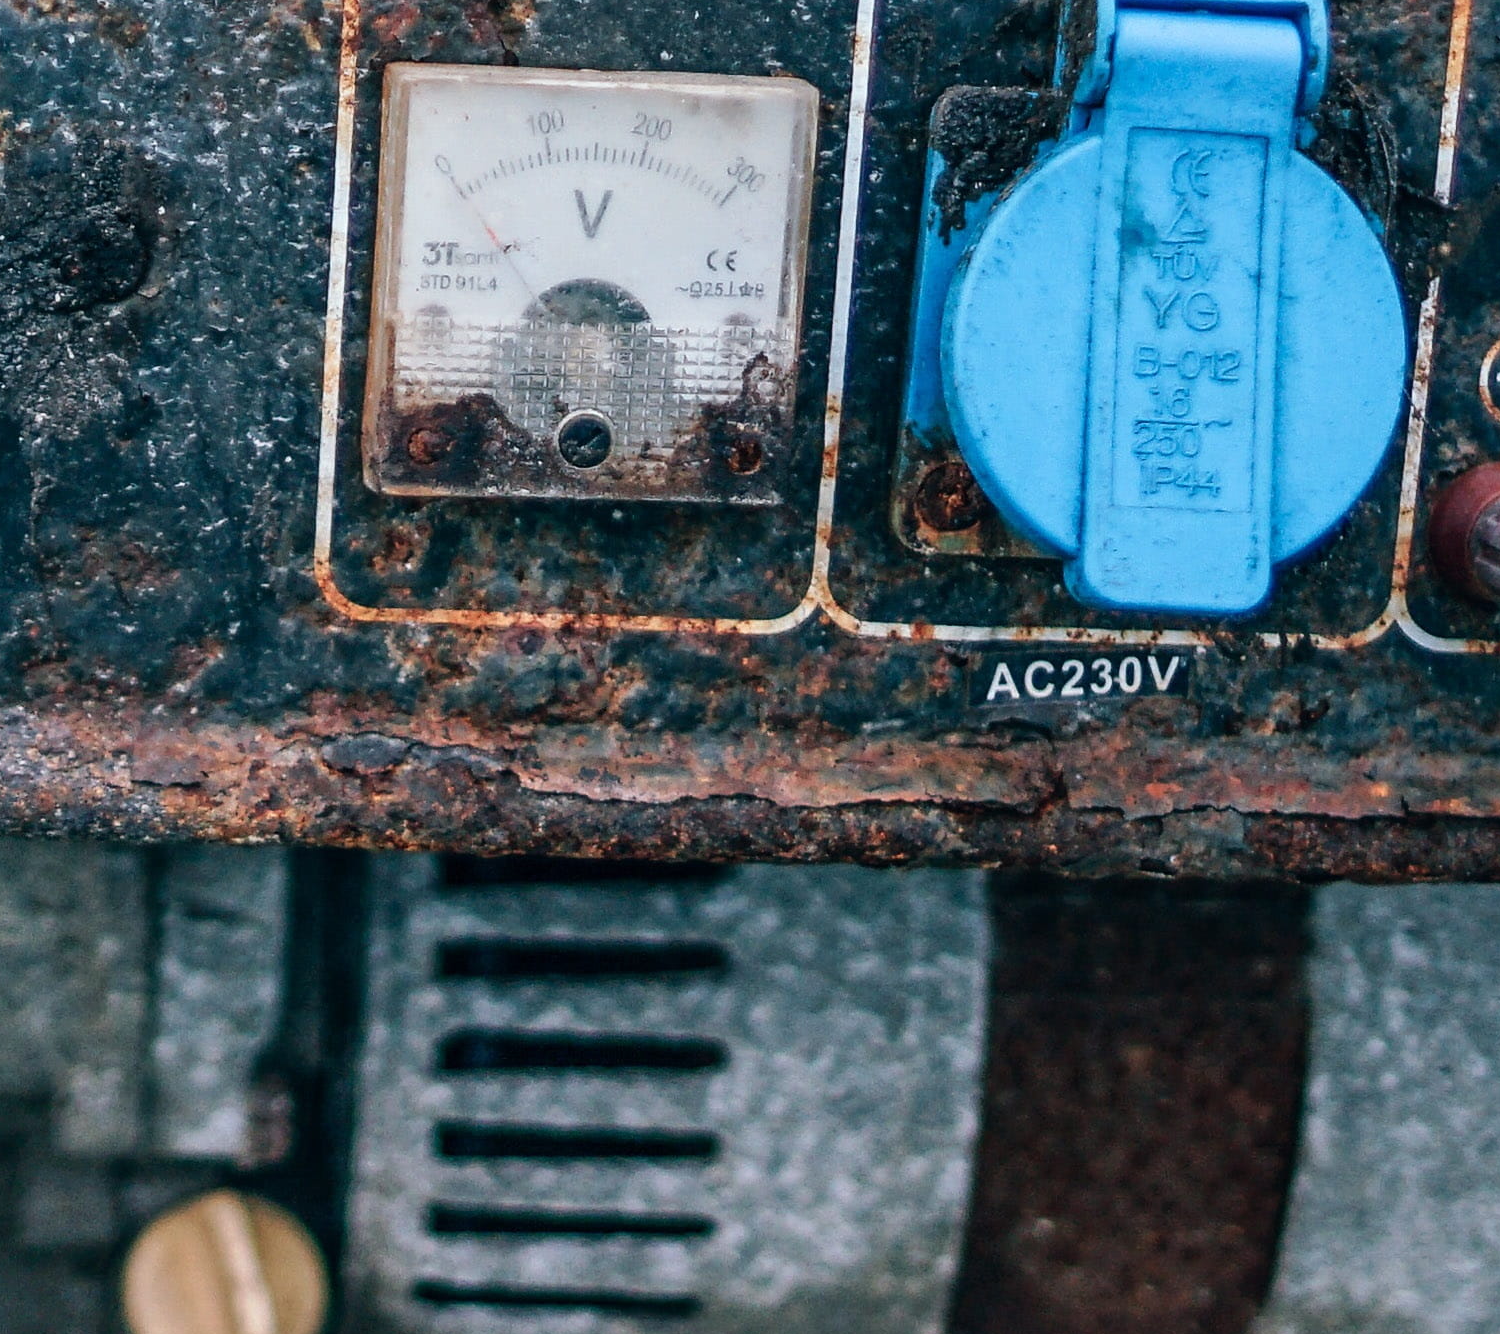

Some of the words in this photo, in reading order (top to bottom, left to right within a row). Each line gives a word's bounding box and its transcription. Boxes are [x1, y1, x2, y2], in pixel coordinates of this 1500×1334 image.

[527, 108, 565, 136] 100
[630, 111, 673, 141] 200
[435, 154, 451, 175] 0
[727, 156, 766, 193] 300
[574, 188, 614, 239] V
[1133, 424, 1200, 458] 250
[986, 656, 1180, 701] AC230V
